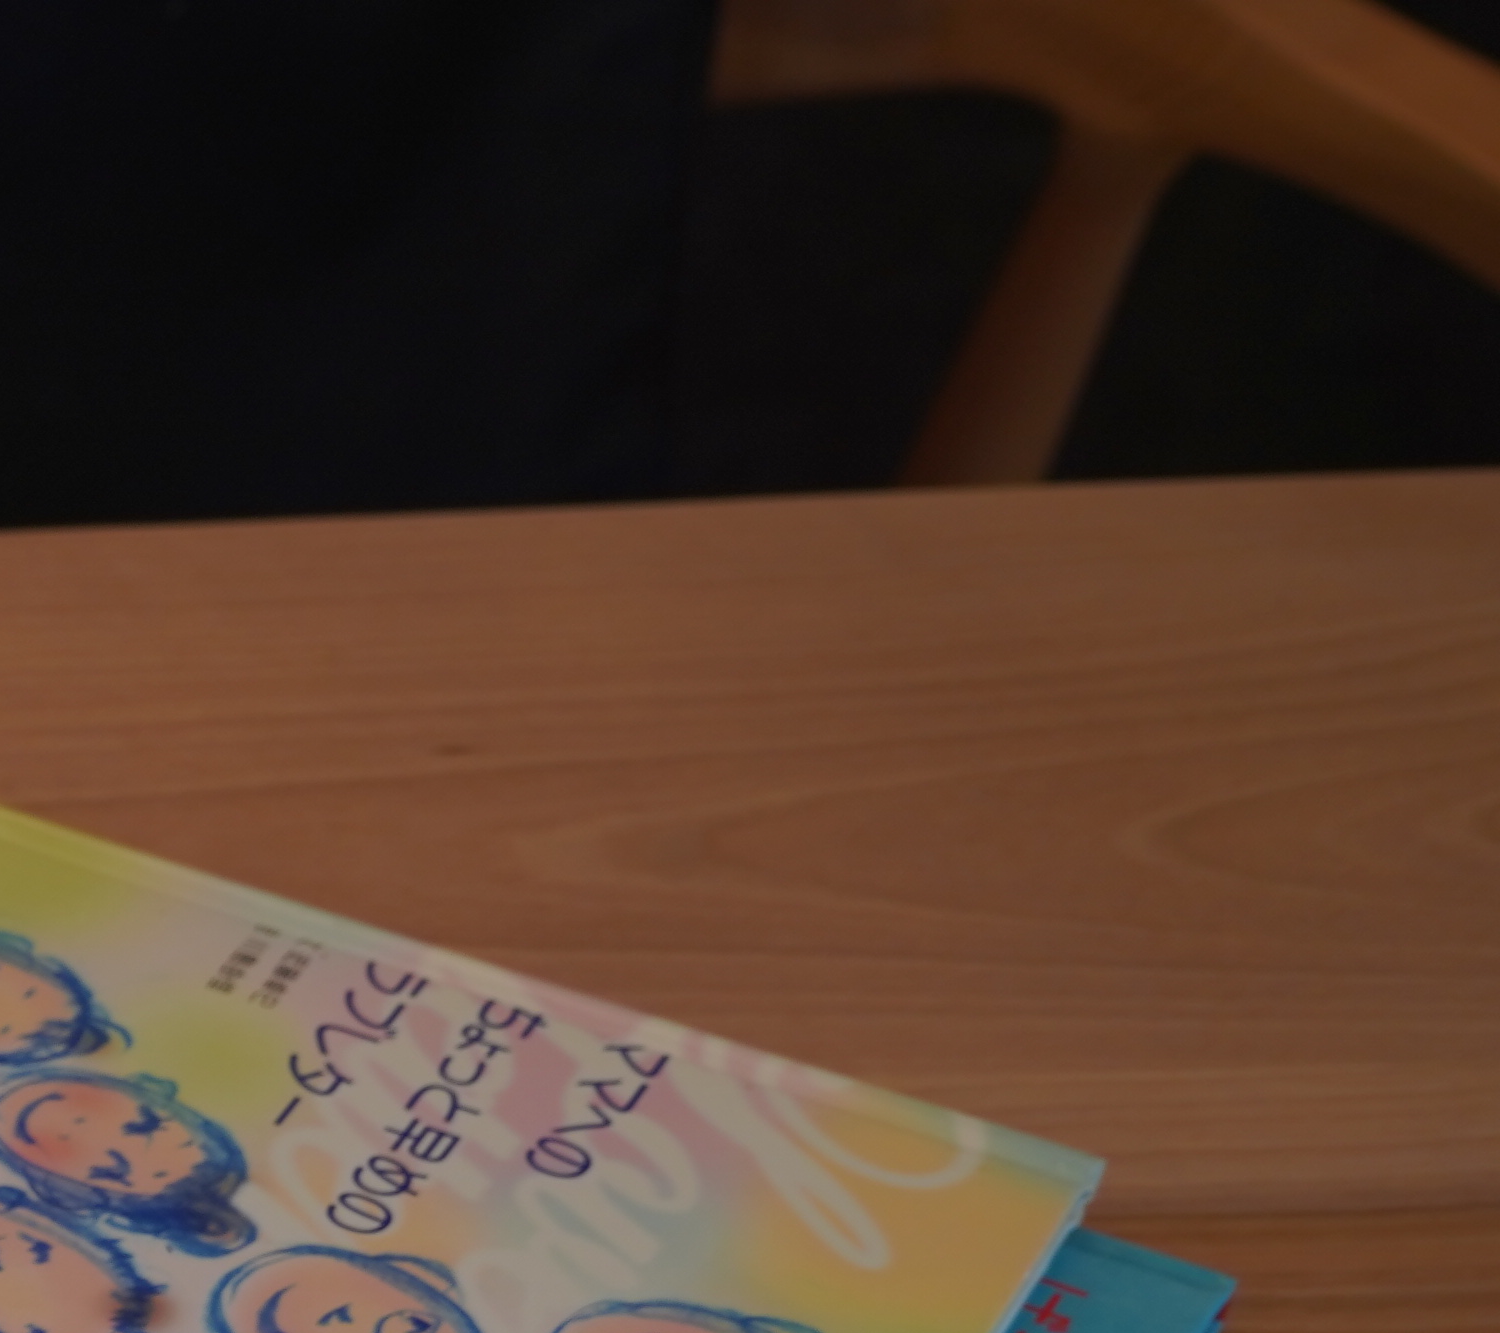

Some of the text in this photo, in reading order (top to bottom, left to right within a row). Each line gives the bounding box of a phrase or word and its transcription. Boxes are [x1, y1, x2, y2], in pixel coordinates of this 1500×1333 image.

[273, 960, 430, 1127] ラブレター
[326, 999, 548, 1235] ちょっと早めの
[525, 1042, 669, 1180] ママへの
